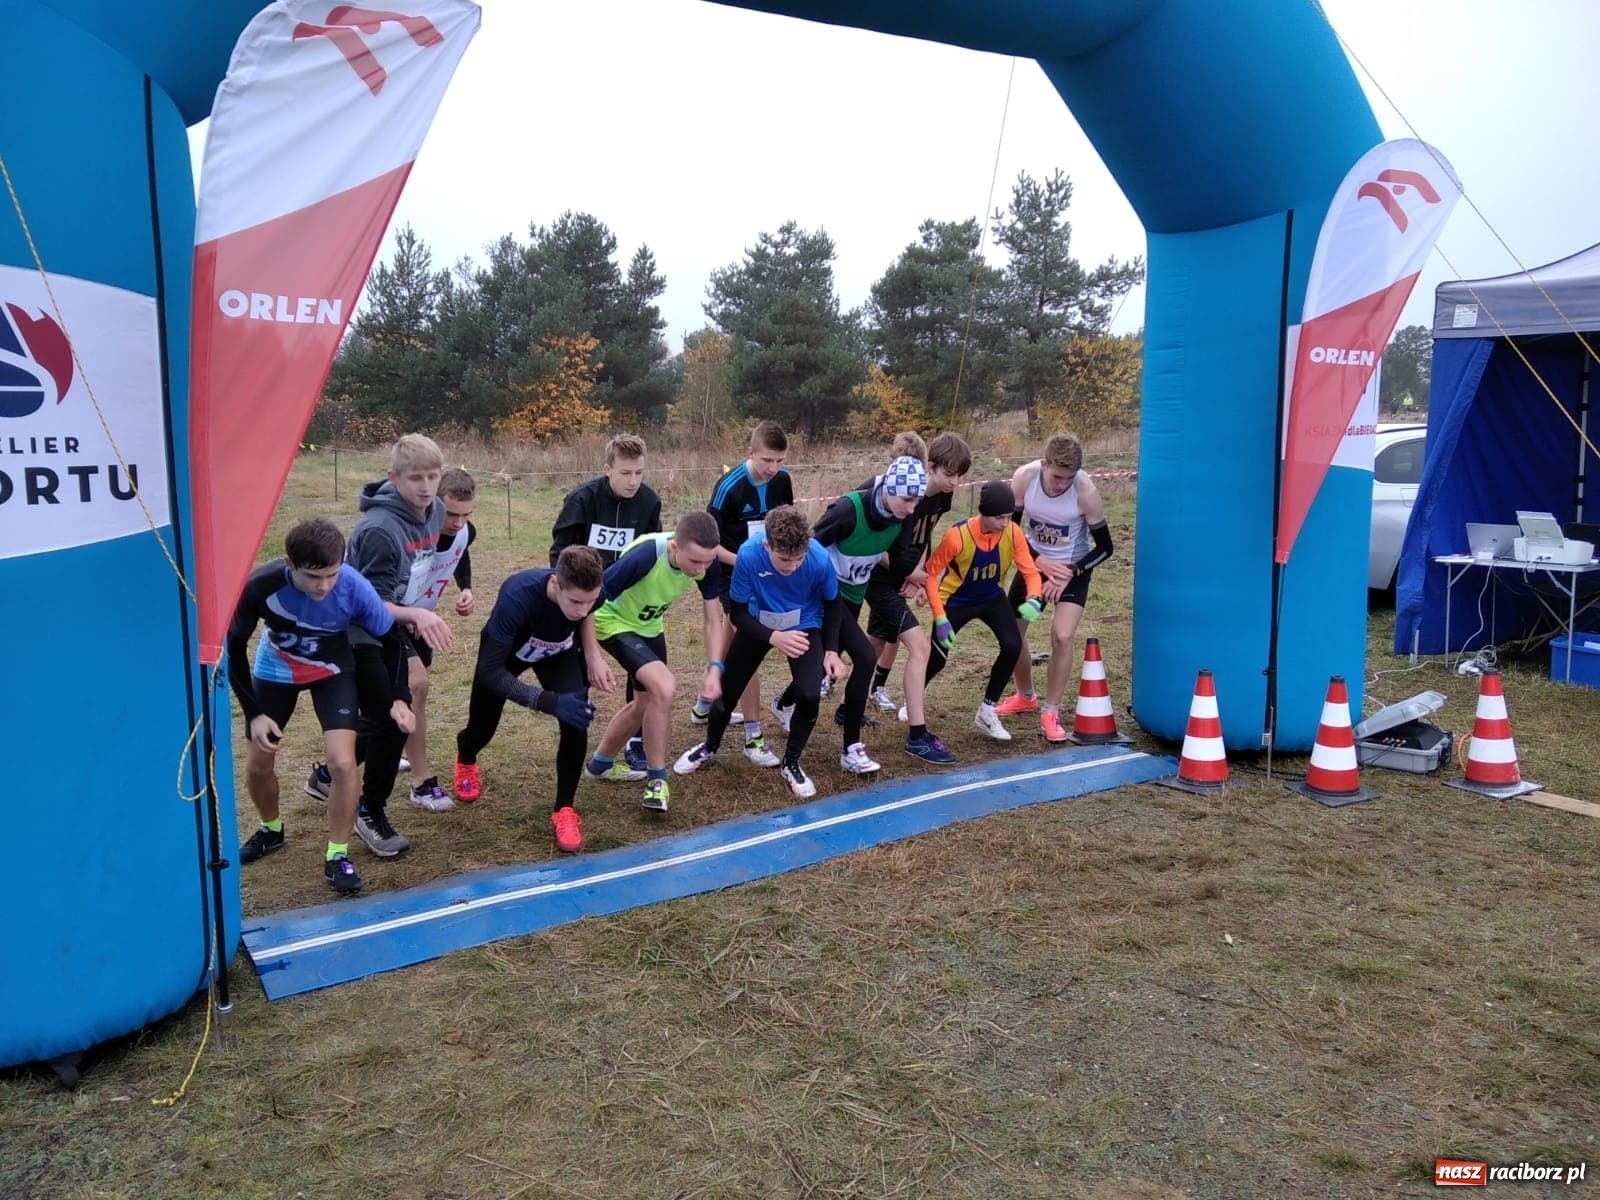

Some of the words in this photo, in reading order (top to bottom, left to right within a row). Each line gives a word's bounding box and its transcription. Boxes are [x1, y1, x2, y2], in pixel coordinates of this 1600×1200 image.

[218, 289, 342, 325] ORLEN
[1309, 346, 1375, 367] ORLEN
[0, 436, 81, 454] LIER
[596, 528, 627, 547] 573
